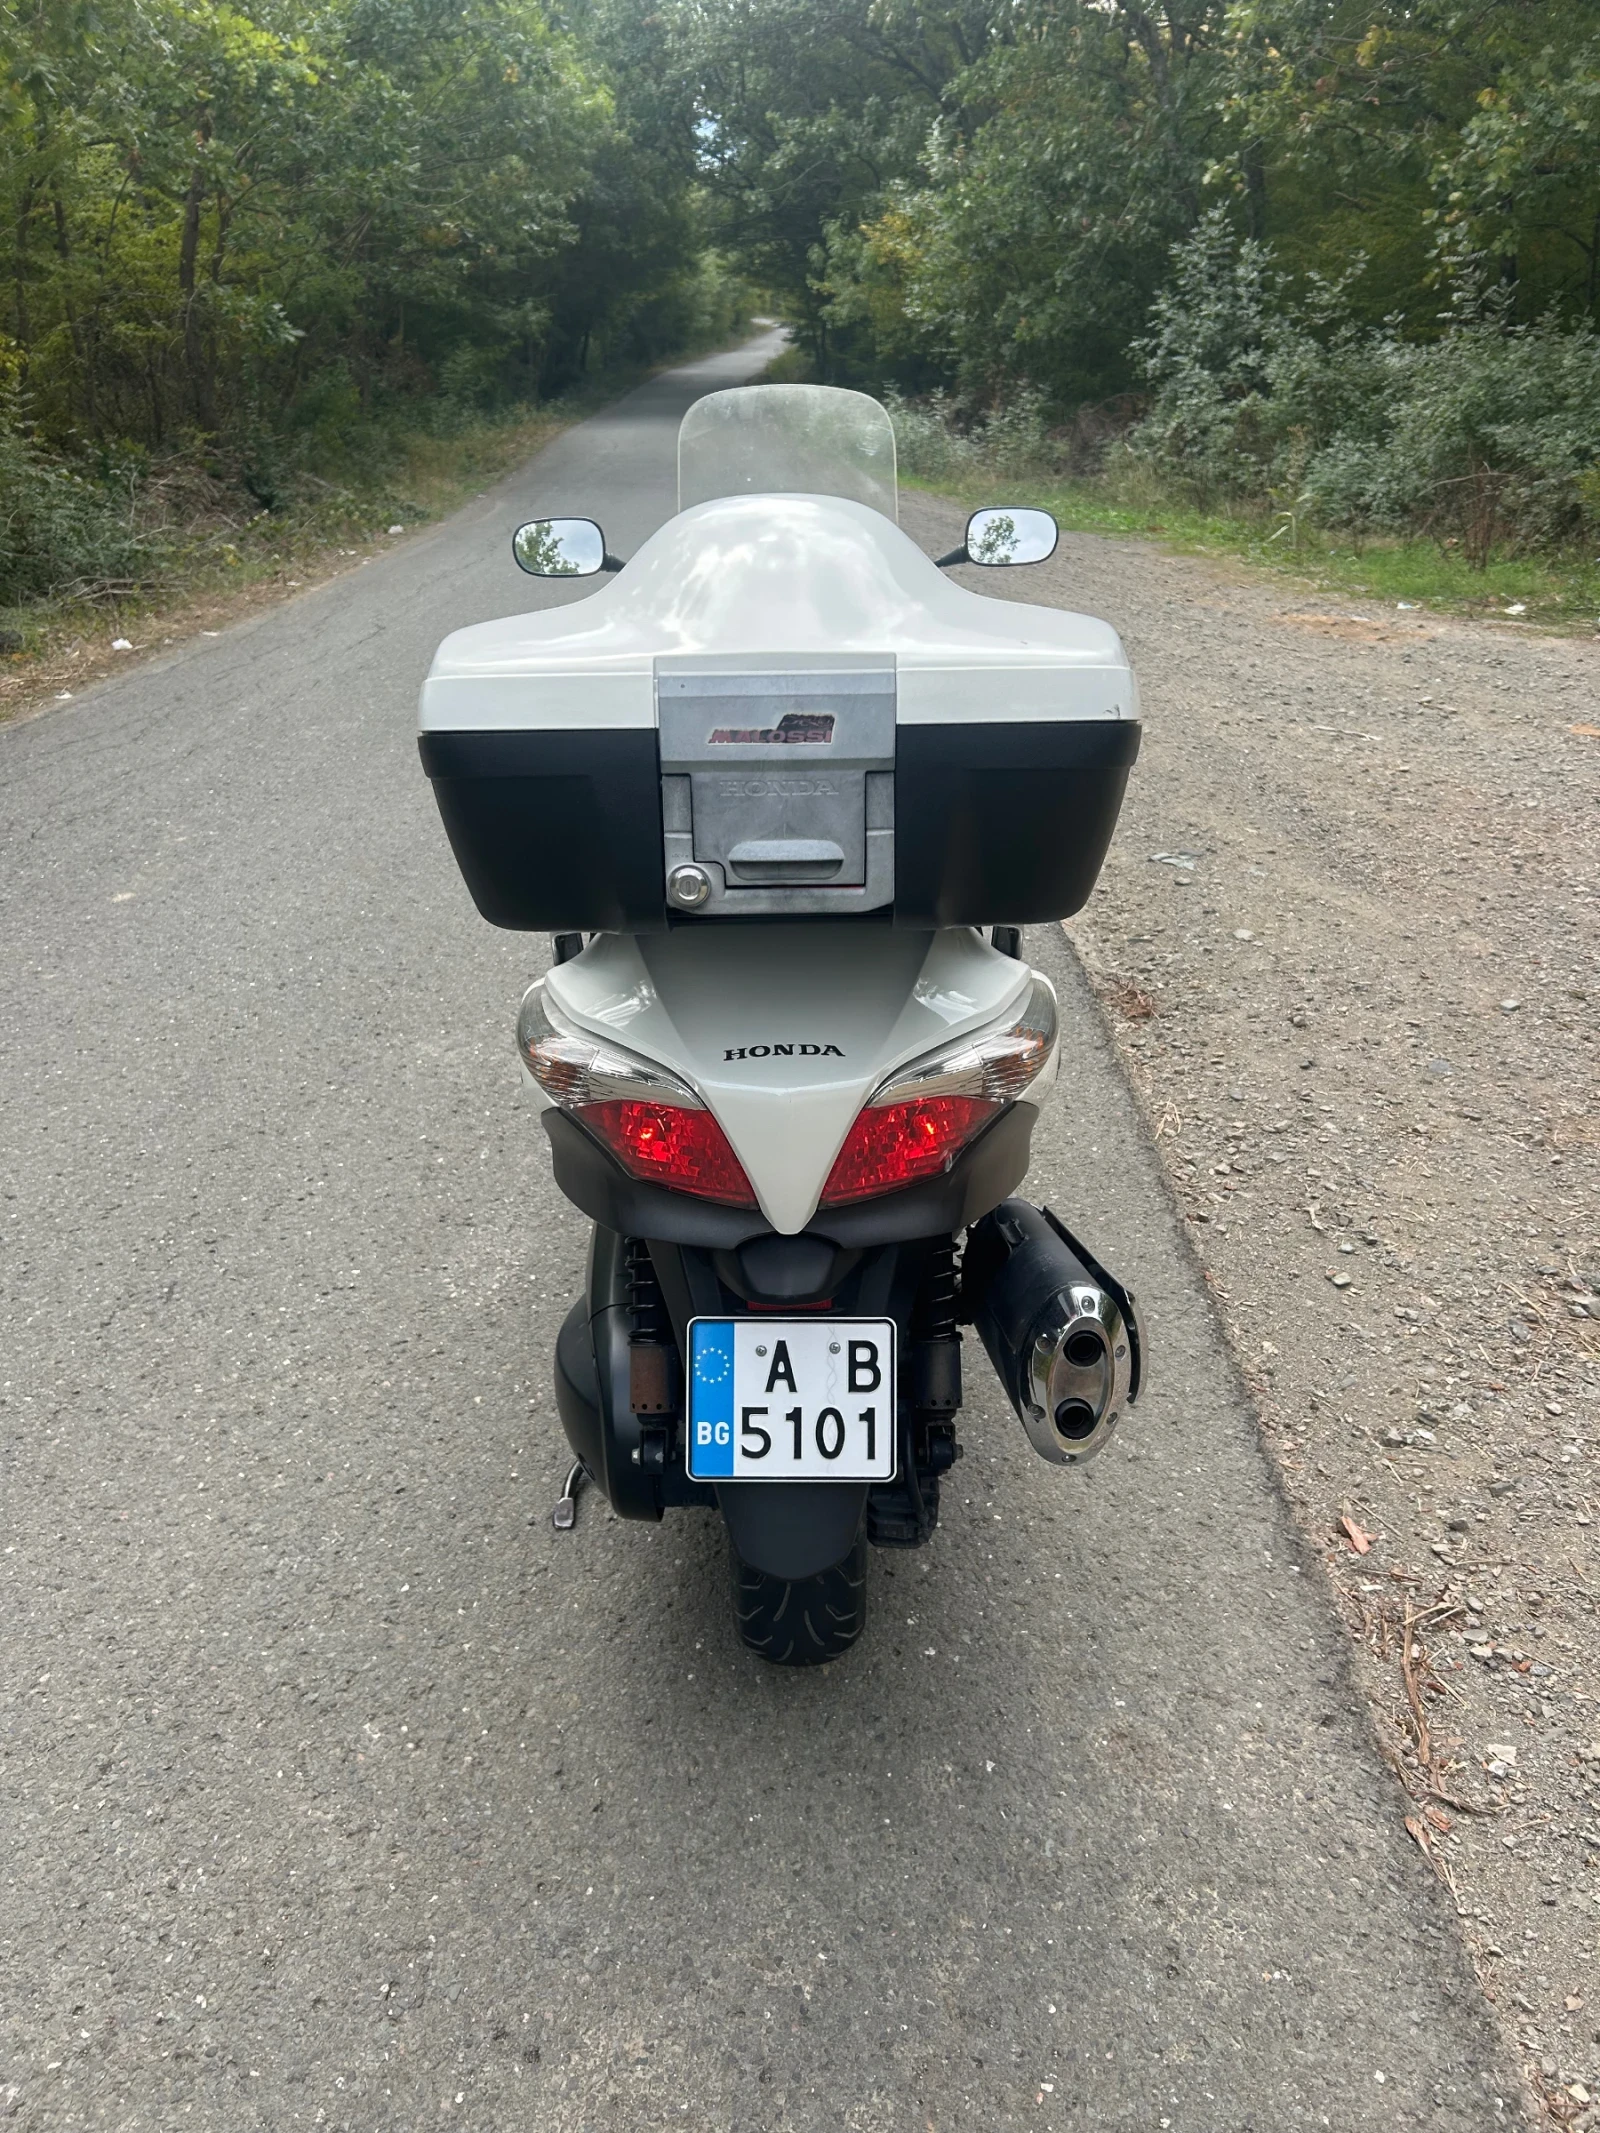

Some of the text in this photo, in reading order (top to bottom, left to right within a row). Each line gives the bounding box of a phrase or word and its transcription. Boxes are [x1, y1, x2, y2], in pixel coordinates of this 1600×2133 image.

[708, 729, 832, 744] MALOSSI
[720, 780, 839, 796] HONDA
[723, 1044, 846, 1061] HONDA
[765, 1340, 881, 1393] A B
[697, 1421, 730, 1445] BG
[741, 1406, 876, 1460] 5101
